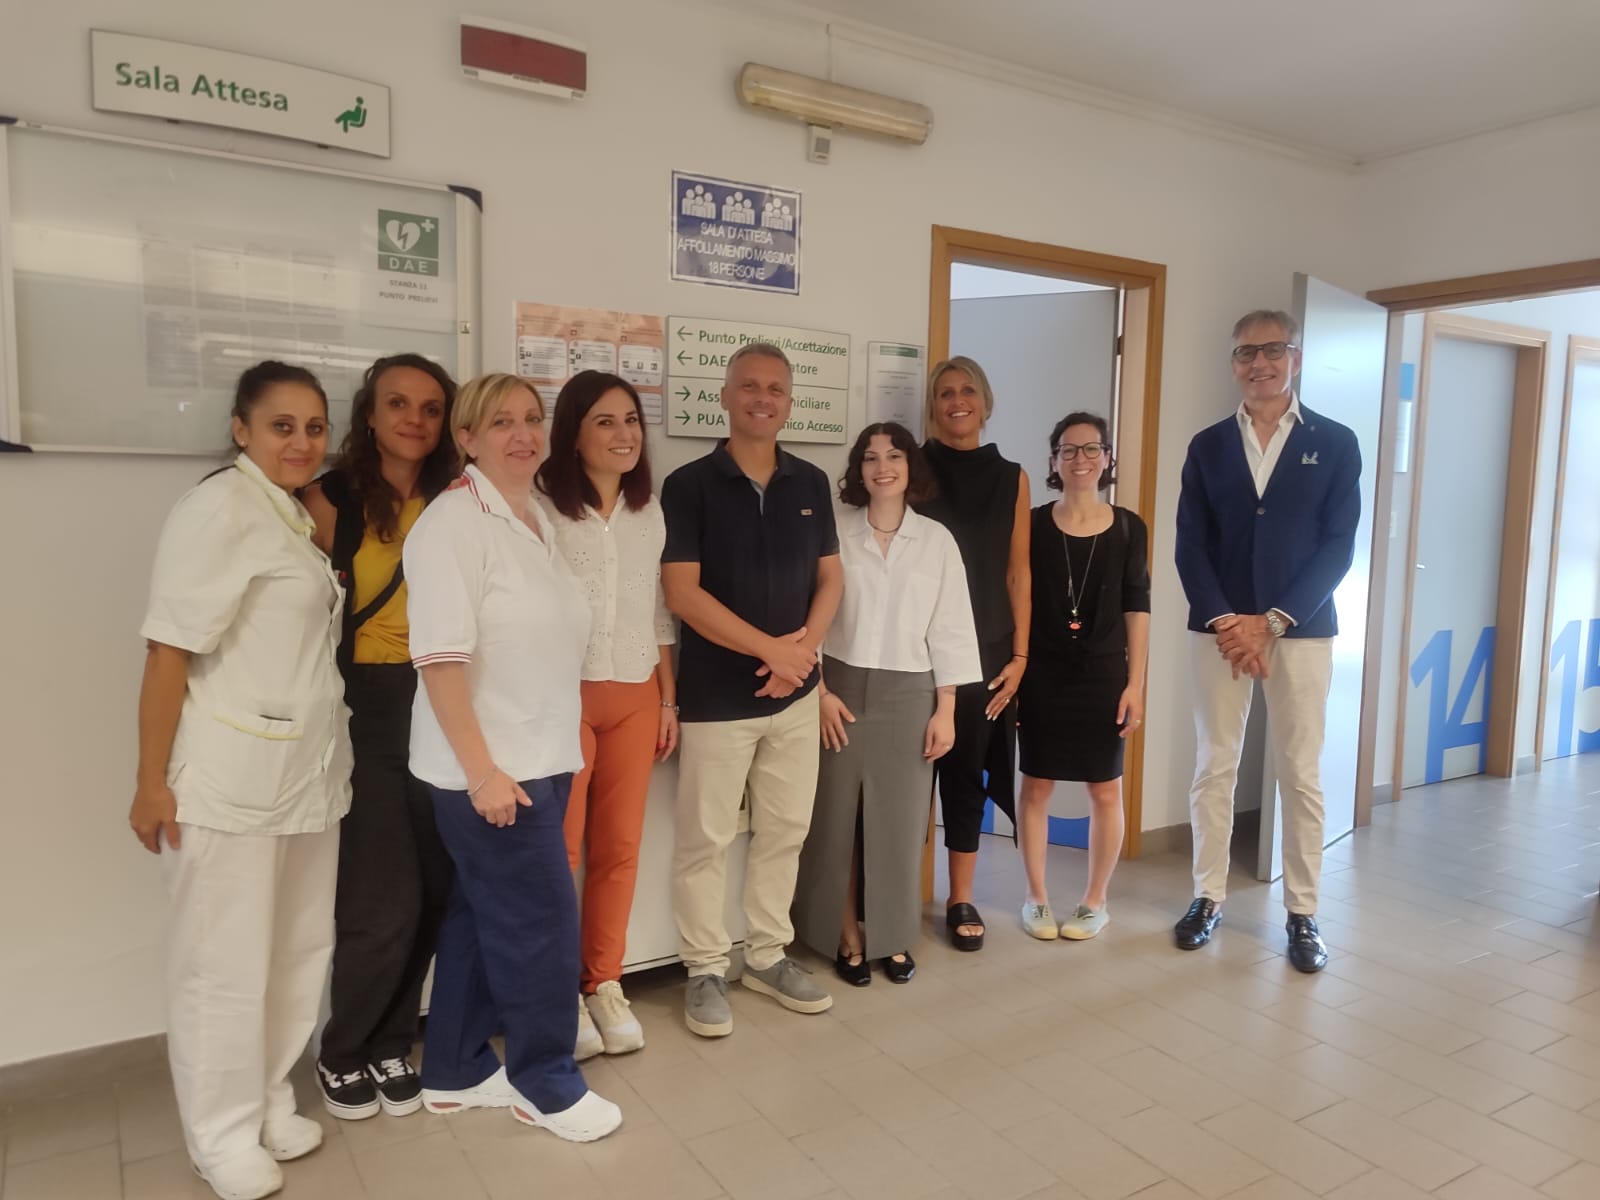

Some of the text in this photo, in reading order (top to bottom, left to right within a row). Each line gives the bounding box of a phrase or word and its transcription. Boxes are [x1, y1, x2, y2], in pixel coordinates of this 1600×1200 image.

[115, 62, 289, 111] Sala Attesa
[700, 221, 725, 238] SALA
[677, 238, 796, 266] AFFOLLAMENTO MASSIMO
[388, 256, 429, 273] DAE
[708, 261, 766, 281] 18 PERSONE
[379, 291, 405, 300] PUNTO
[699, 330, 736, 345] Punto
[699, 353, 727, 367] DAE
[792, 397, 831, 411] iciliare
[697, 413, 726, 427] PUA
[807, 420, 844, 433] Accesso
[1409, 626, 1497, 785] 14
